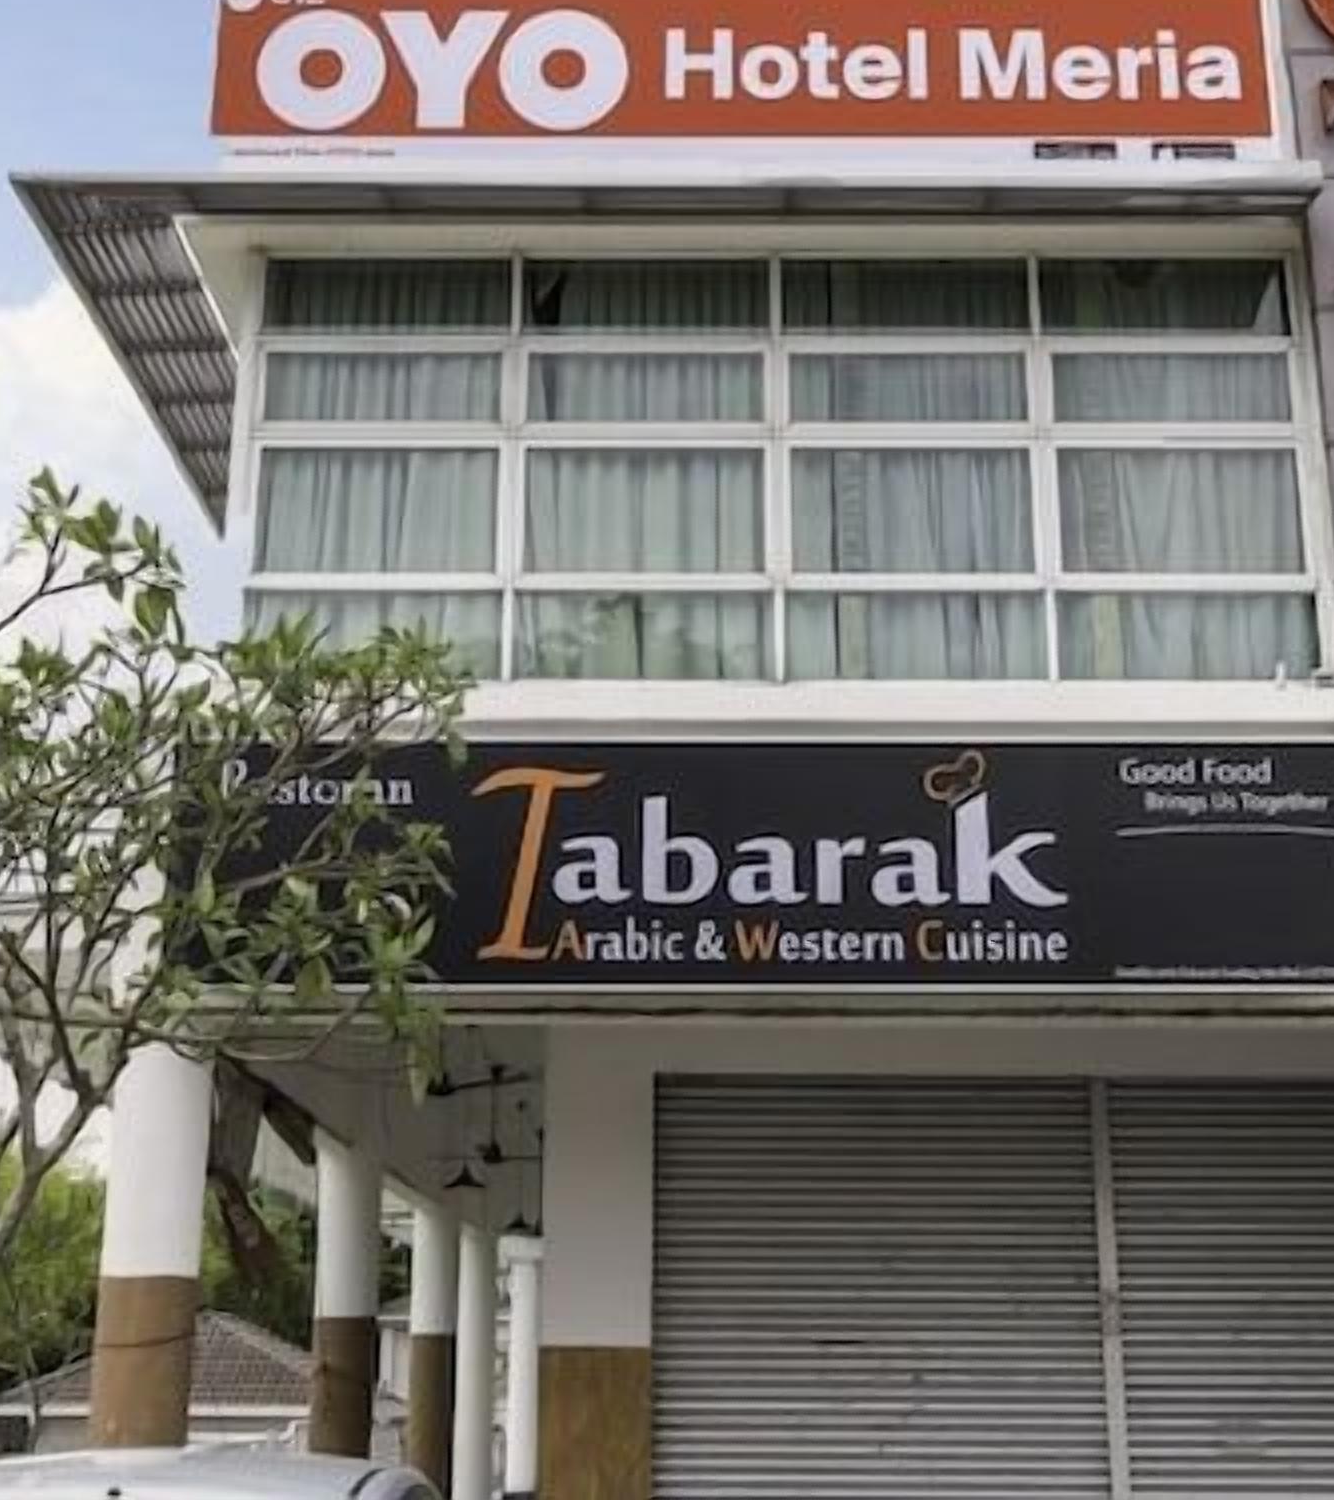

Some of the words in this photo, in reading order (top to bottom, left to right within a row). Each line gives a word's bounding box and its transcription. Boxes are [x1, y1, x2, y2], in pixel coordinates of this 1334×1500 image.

[256, 9, 629, 131] OYO
[664, 28, 929, 100] Hotel
[959, 27, 1243, 100] Meria
[1119, 757, 1195, 784] Good
[1202, 757, 1272, 784] Food
[471, 766, 1069, 962] Tabarak
[554, 917, 683, 962] Arabic
[695, 919, 725, 962] &
[734, 920, 904, 962] Western
[916, 919, 1068, 963] Cuisine
